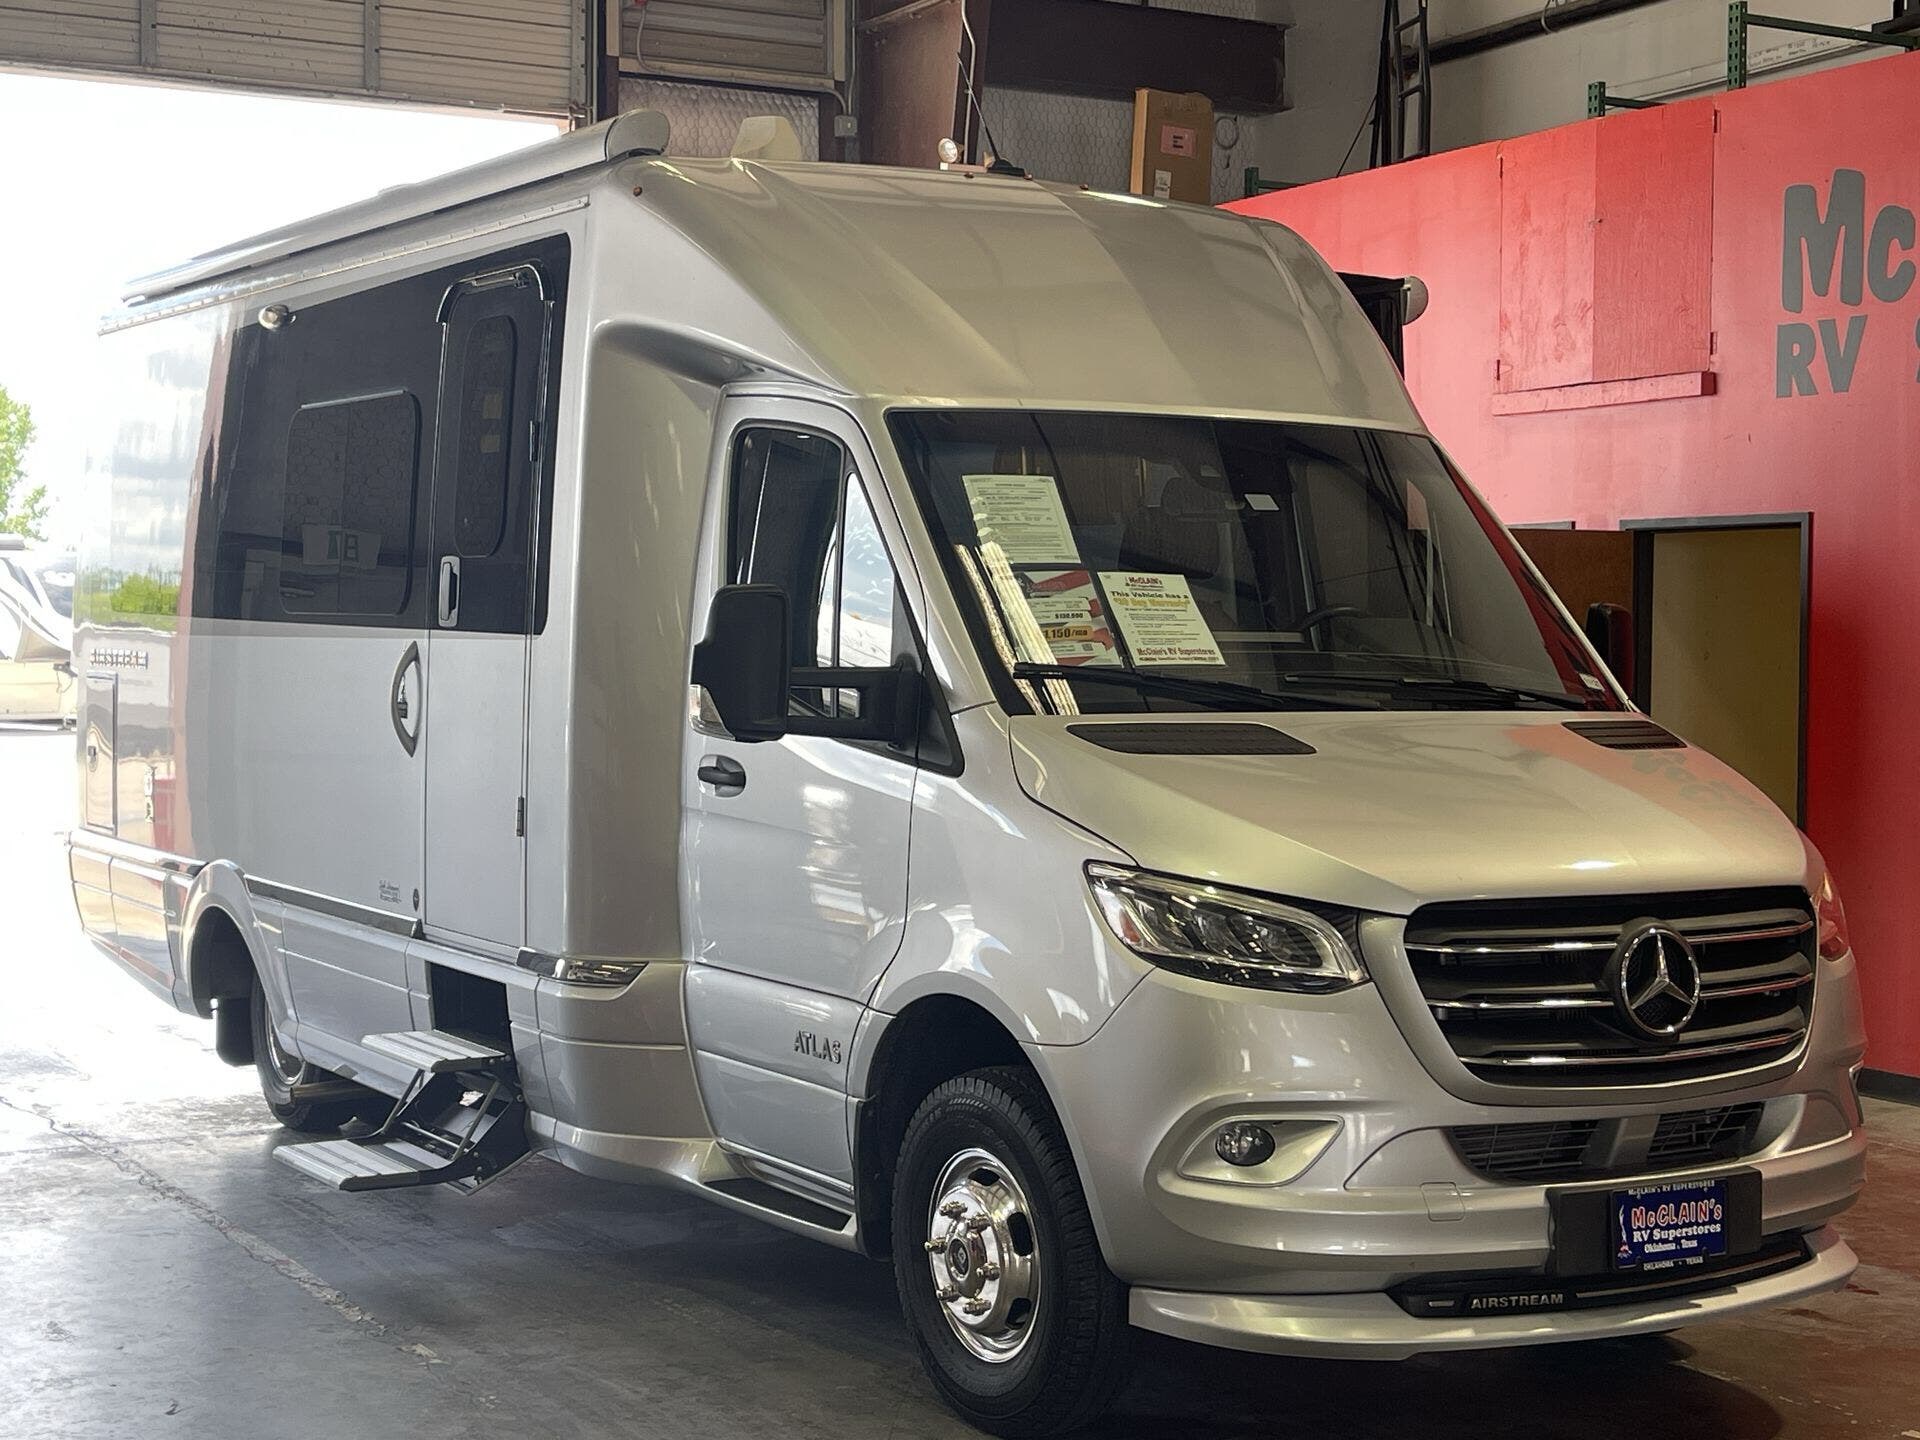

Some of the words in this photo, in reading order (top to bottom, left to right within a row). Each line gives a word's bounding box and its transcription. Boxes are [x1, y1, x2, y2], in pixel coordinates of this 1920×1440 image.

[1776, 314, 1868, 398] RV
[1111, 590, 1130, 598] This
[1132, 591, 1164, 599] Vehicle
[1168, 647, 1178, 656] RV
[794, 1030, 841, 1064] ATLAS
[1662, 1184, 1671, 1192] RV
[1633, 1230, 1651, 1243] RV
[1652, 1223, 1721, 1240] Superstores
[1644, 1243, 1676, 1253] Oklahoma
[1680, 1239, 1698, 1249] Texas
[1643, 1260, 1675, 1271] OKLAHOMA
[1685, 1256, 1704, 1265] TEXAS
[1471, 1293, 1563, 1309] AIRSTREAM
